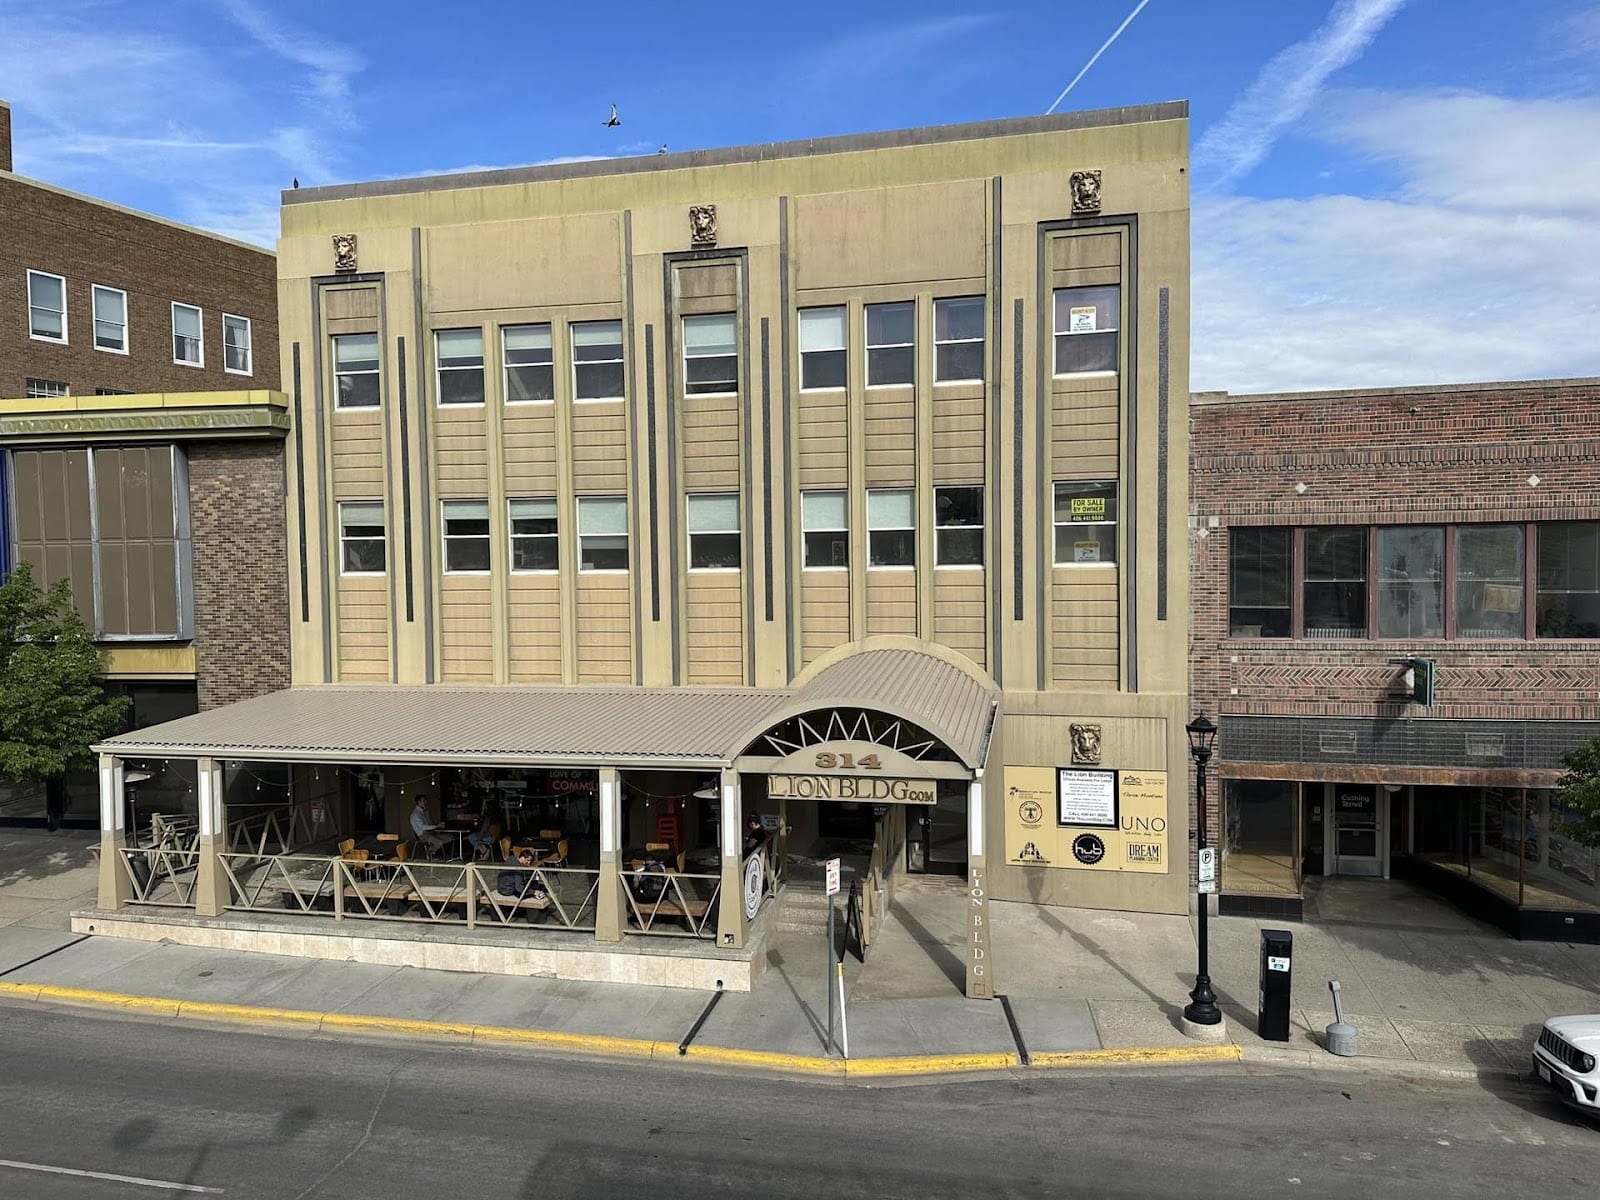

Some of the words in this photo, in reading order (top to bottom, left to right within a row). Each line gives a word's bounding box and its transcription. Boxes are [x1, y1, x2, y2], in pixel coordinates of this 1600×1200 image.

[815, 752, 882, 770] 314
[769, 775, 833, 798] LION
[838, 777, 910, 800] BLDG
[1341, 794, 1369, 802] Cushing
[1121, 816, 1166, 832] UNO
[1075, 842, 1102, 854] hub
[1129, 844, 1159, 857] DREAM
[971, 869, 983, 906] LION
[973, 915, 984, 976] BLDG
